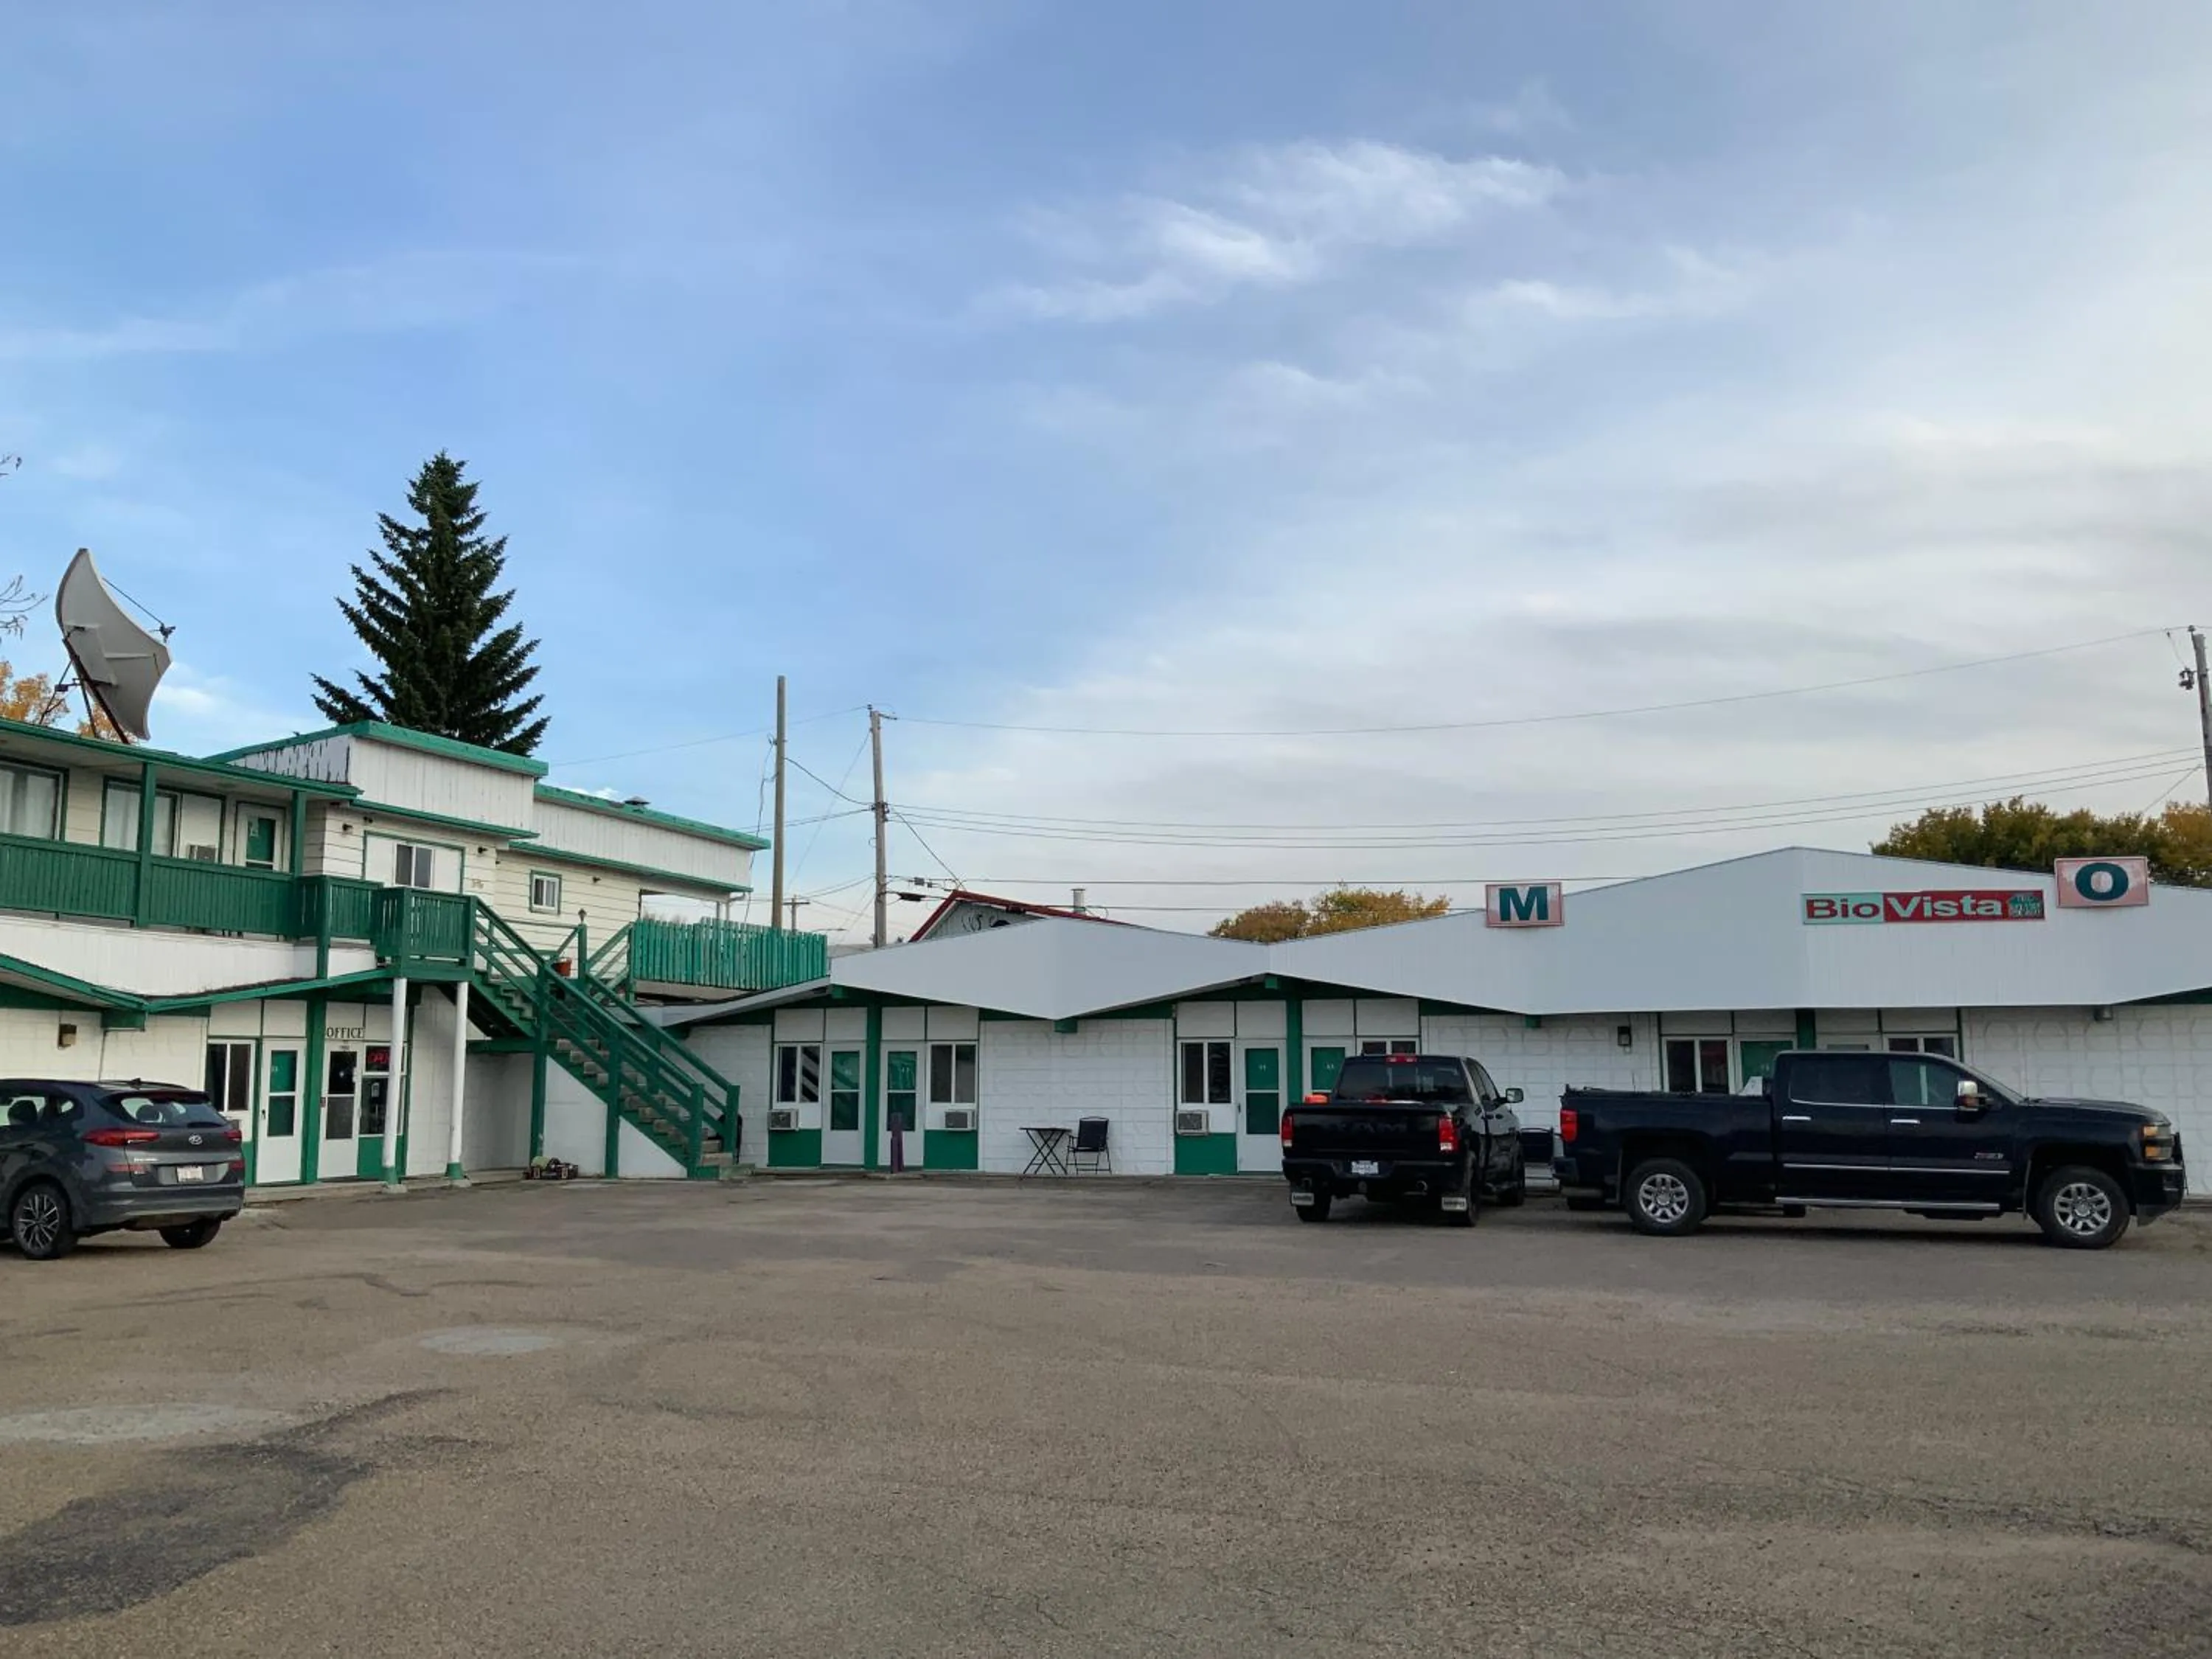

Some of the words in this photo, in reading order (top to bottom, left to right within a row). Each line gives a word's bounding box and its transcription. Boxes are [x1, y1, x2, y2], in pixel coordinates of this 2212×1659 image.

[2075, 862, 2129, 901] O
[1499, 886, 1548, 921] M
[327, 1026, 365, 1039] OFFICE
